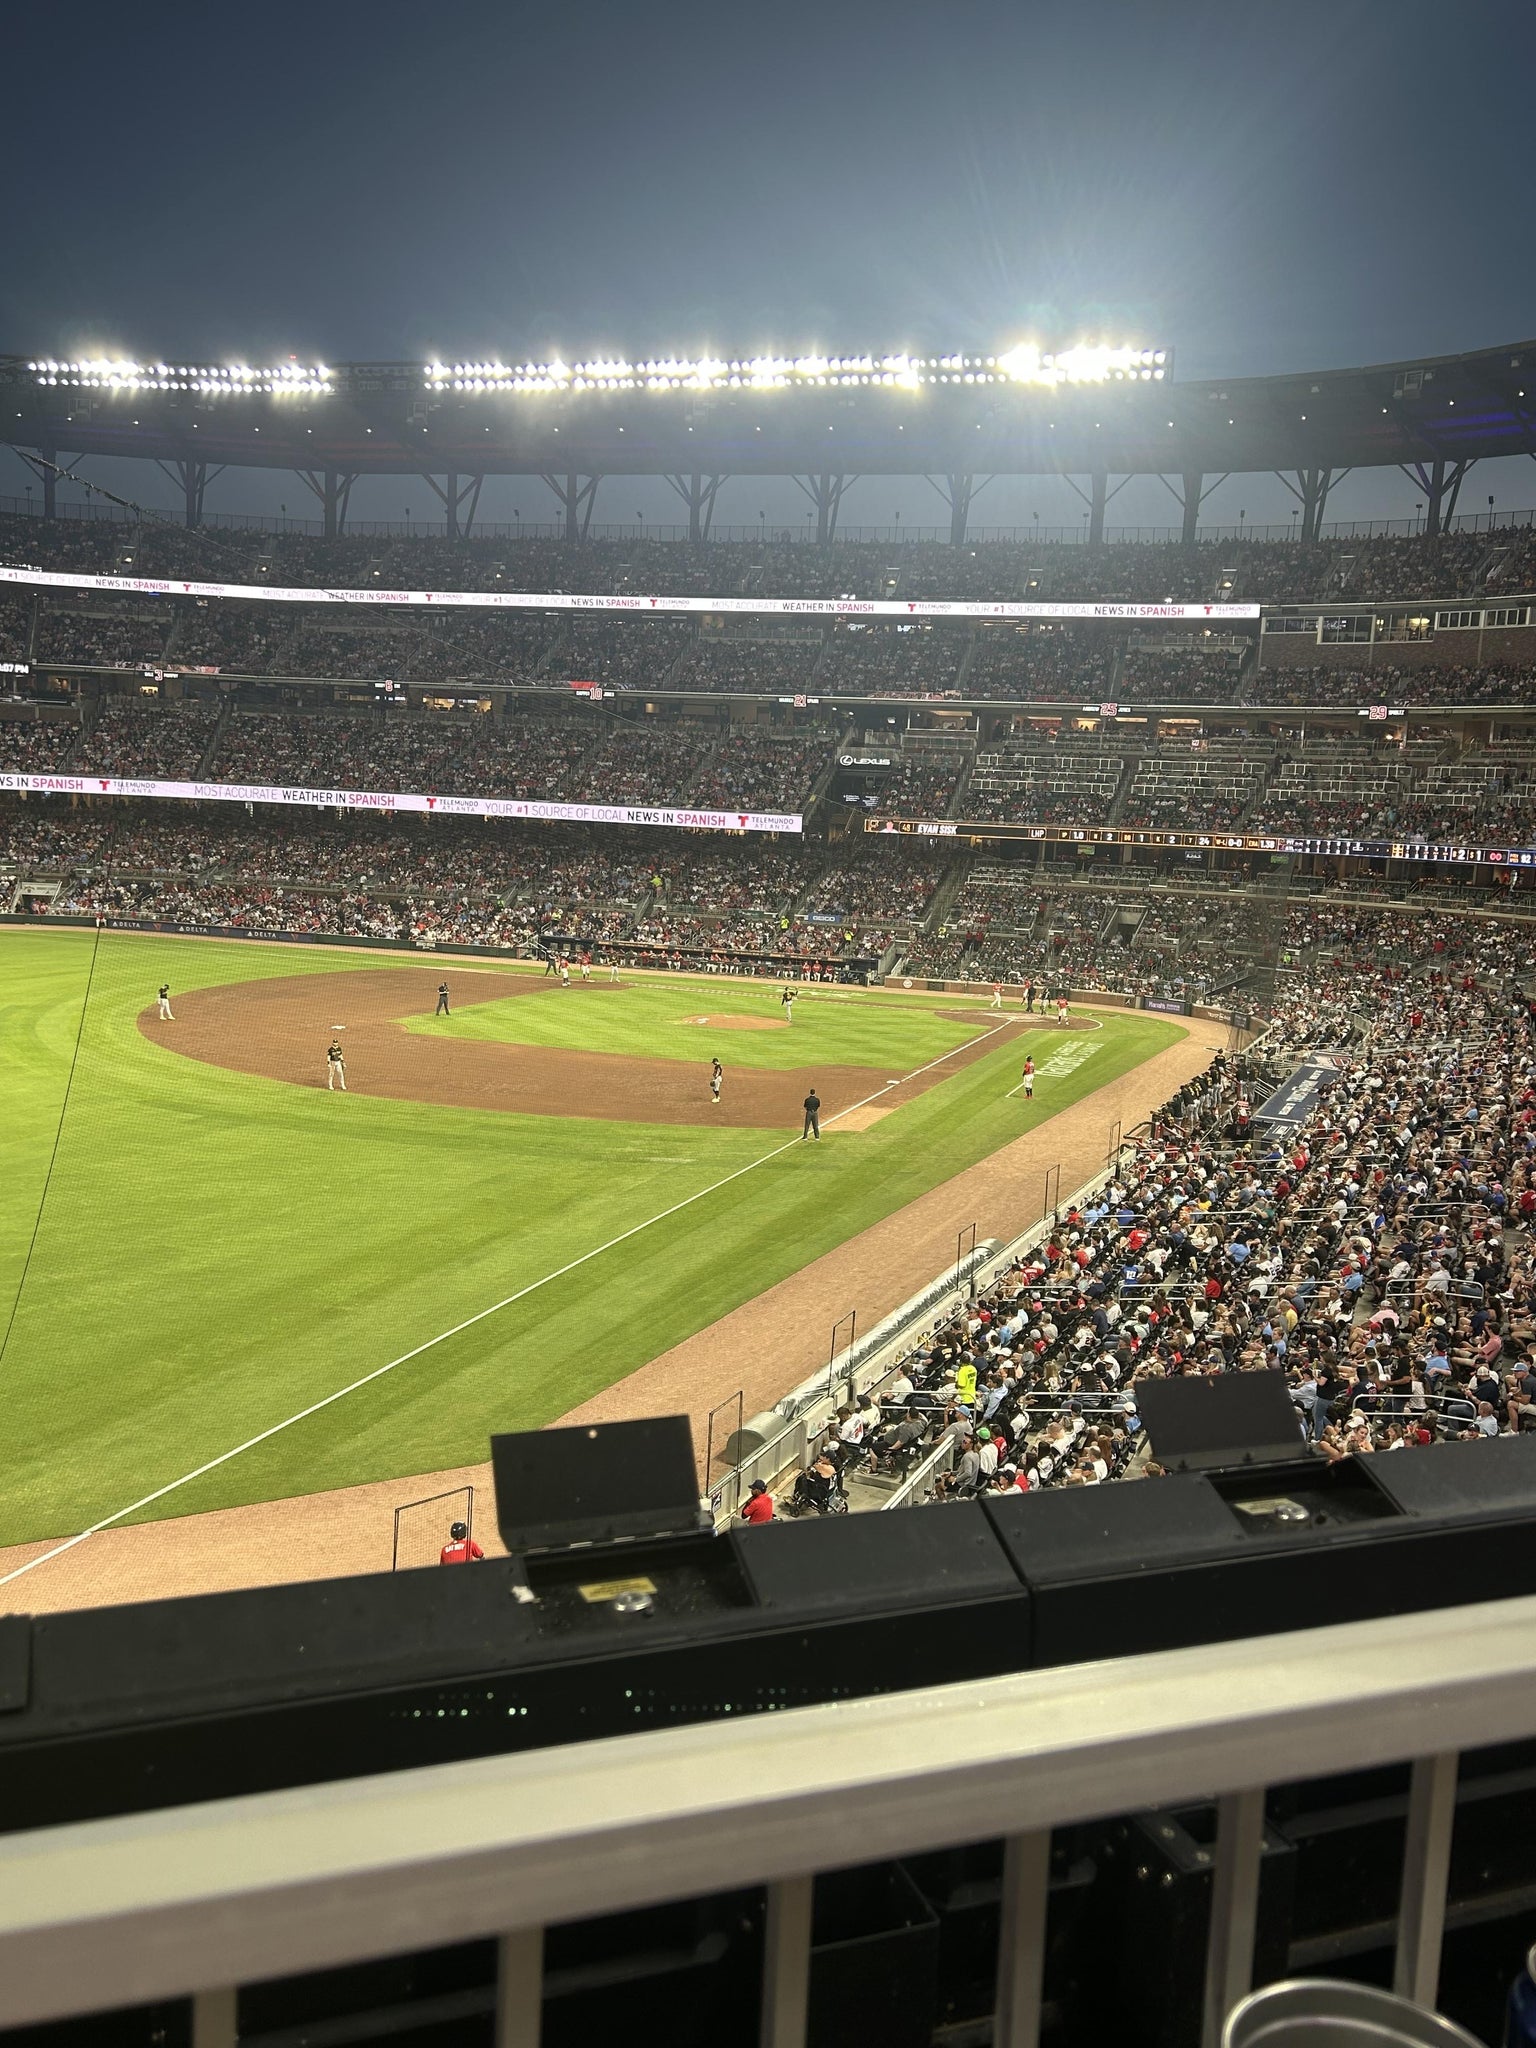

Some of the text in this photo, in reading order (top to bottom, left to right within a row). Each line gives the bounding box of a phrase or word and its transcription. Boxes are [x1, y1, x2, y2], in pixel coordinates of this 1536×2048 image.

[95, 579, 121, 587] NEWS
[122, 580, 131, 589] IN
[133, 581, 170, 590] SPANISH
[328, 592, 364, 600] WEATHER
[376, 593, 409, 602] SPANISH
[606, 599, 640, 607] SPANISH
[783, 602, 824, 611] WEATHER
[826, 603, 835, 611] IN
[837, 604, 874, 612] SPANISH
[965, 605, 990, 613] YOUR
[1008, 606, 1044, 614] SOURCE
[1048, 606, 1059, 614] OF
[1062, 606, 1091, 614] LOCAL
[1094, 606, 1124, 615] NEWS
[1126, 606, 1137, 615] IN
[1140, 606, 1185, 616] SPANISH
[14, 664, 29, 674] PM
[154, 668, 163, 681] 3
[385, 680, 393, 692] 6
[589, 687, 603, 701] 10
[794, 694, 807, 708] 21
[1100, 703, 1118, 716] 25
[1369, 705, 1387, 720] 29
[853, 758, 891, 767] LEXUS
[17, 777, 29, 787] IN
[32, 777, 83, 790] SPANISH
[194, 785, 395, 807] MOST ACCURATE WEATHER IN SPANISH
[439, 799, 479, 807] TELEMUNDO
[485, 802, 726, 826] YOUR #1 SOURCE OF LOCAL NEWS IN SPANISH
[752, 816, 794, 825] TELEMUNDO
[917, 824, 939, 834] EVAN
[939, 825, 958, 835] SISK
[1030, 829, 1044, 838] LHP
[1073, 831, 1085, 840] 1.0
[1106, 833, 1113, 841] 2
[1139, 834, 1145, 843] 1
[1169, 836, 1176, 844] 2
[1198, 836, 1210, 845] 24
[1228, 838, 1243, 847] 0-0
[1457, 849, 1466, 860] 2
[1469, 851, 1475, 859] S
[1476, 850, 1482, 861] 1
[812, 914, 836, 922] GEICO
[119, 920, 141, 929] DELTA
[185, 925, 208, 934] DELTA
[254, 931, 277, 939] DELTA
